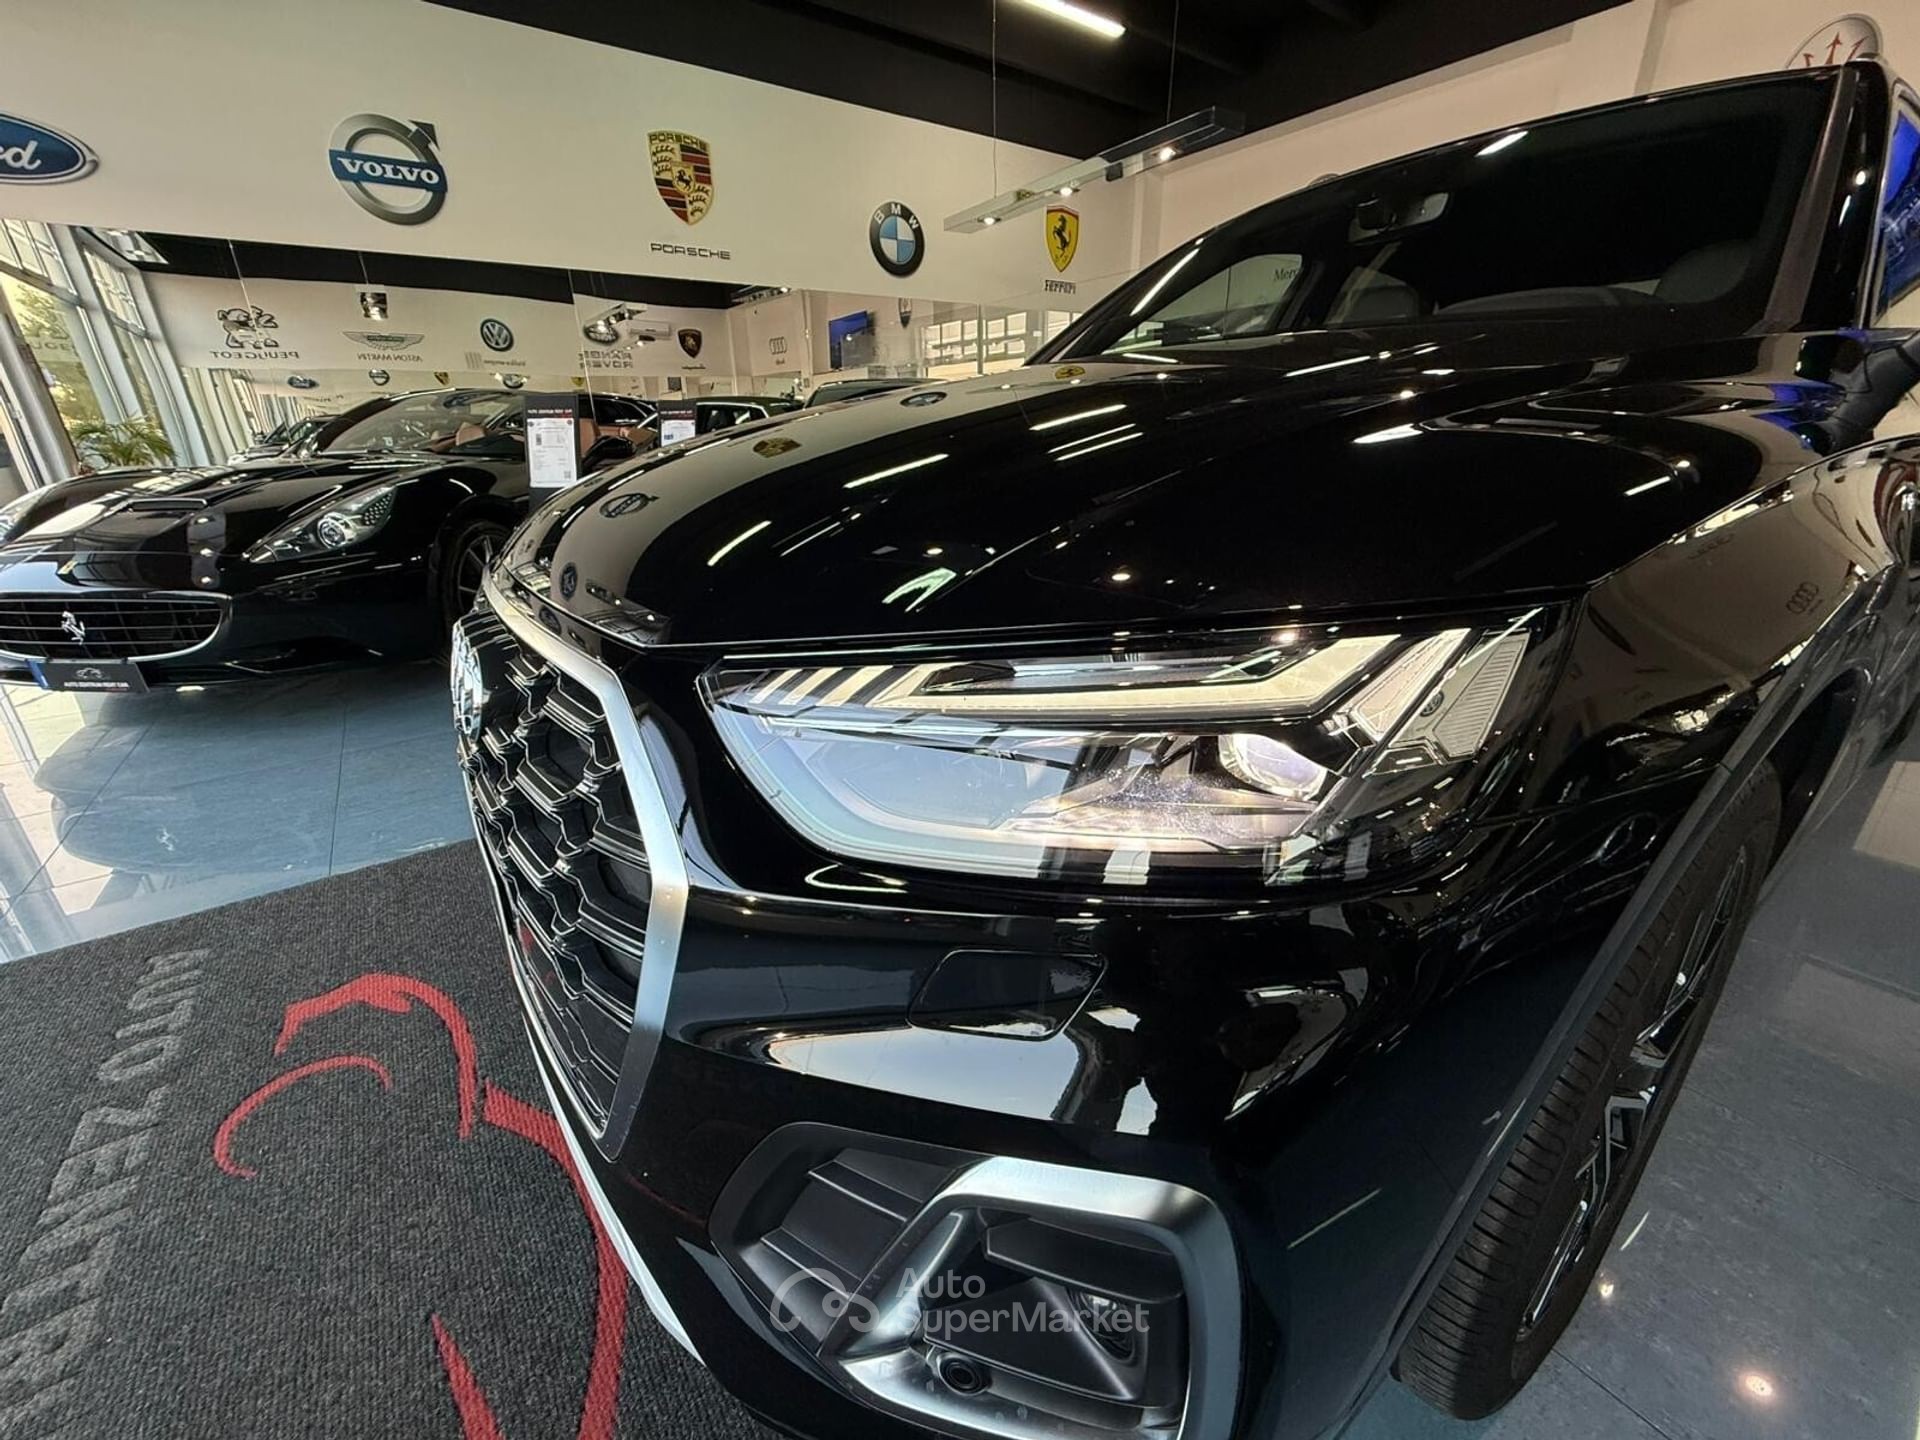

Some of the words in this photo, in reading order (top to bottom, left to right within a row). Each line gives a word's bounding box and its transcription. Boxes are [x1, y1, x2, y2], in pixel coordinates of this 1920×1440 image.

[337, 156, 439, 186] VOLVO
[874, 202, 920, 230] BMW
[650, 243, 731, 260] PORSCHE
